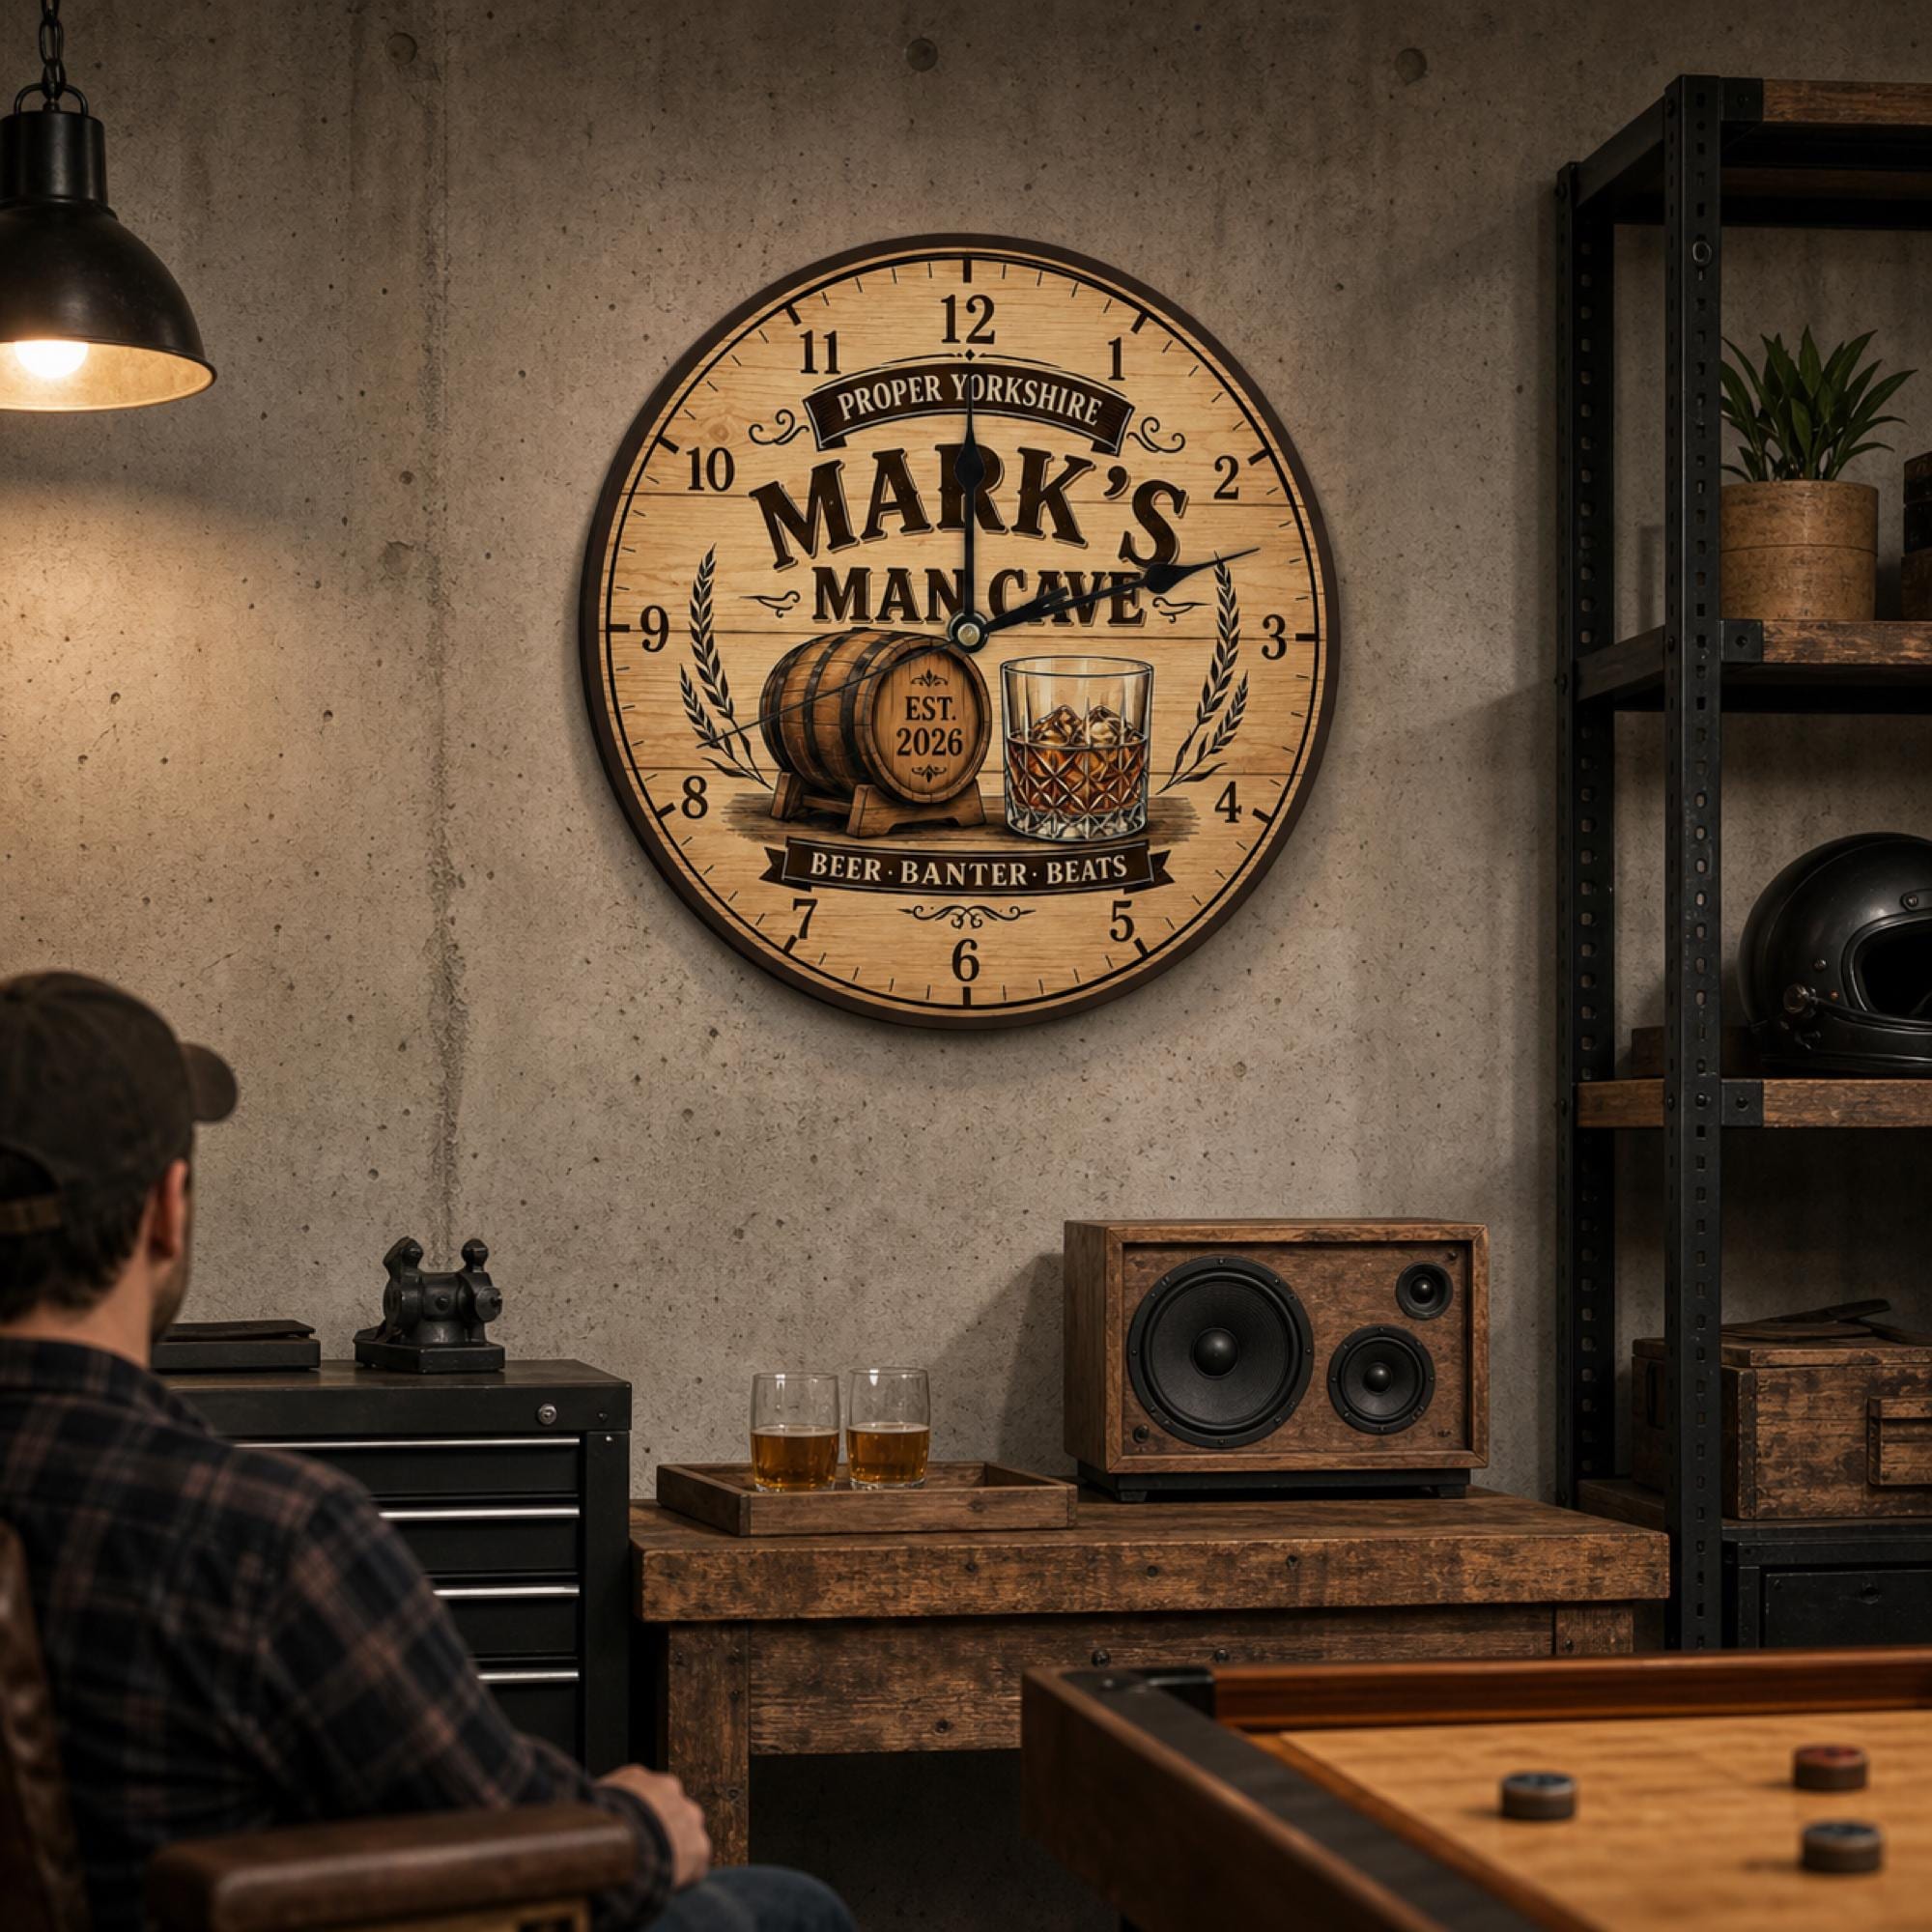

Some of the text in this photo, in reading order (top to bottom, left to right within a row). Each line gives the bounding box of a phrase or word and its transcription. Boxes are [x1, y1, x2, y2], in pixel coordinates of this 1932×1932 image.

[940, 294, 996, 345] 12
[801, 330, 840, 375] 11
[1107, 337, 1125, 382] 1
[837, 373, 1103, 426] PROPER YORKSHIRE
[686, 446, 735, 493] 10
[1213, 455, 1239, 500] 2
[749, 442, 1188, 573] MARK'S
[811, 566, 969, 624] MAN
[639, 605, 670, 653] 9
[1261, 613, 1288, 661] 3
[905, 696, 956, 722] EST.
[895, 727, 963, 756] 2026
[681, 775, 710, 820] 8
[1214, 781, 1242, 824] 4
[810, 852, 1127, 886] BEER BANTER BEATS
[791, 898, 818, 940] 7
[1109, 899, 1135, 943] 5
[952, 938, 980, 982] 6
